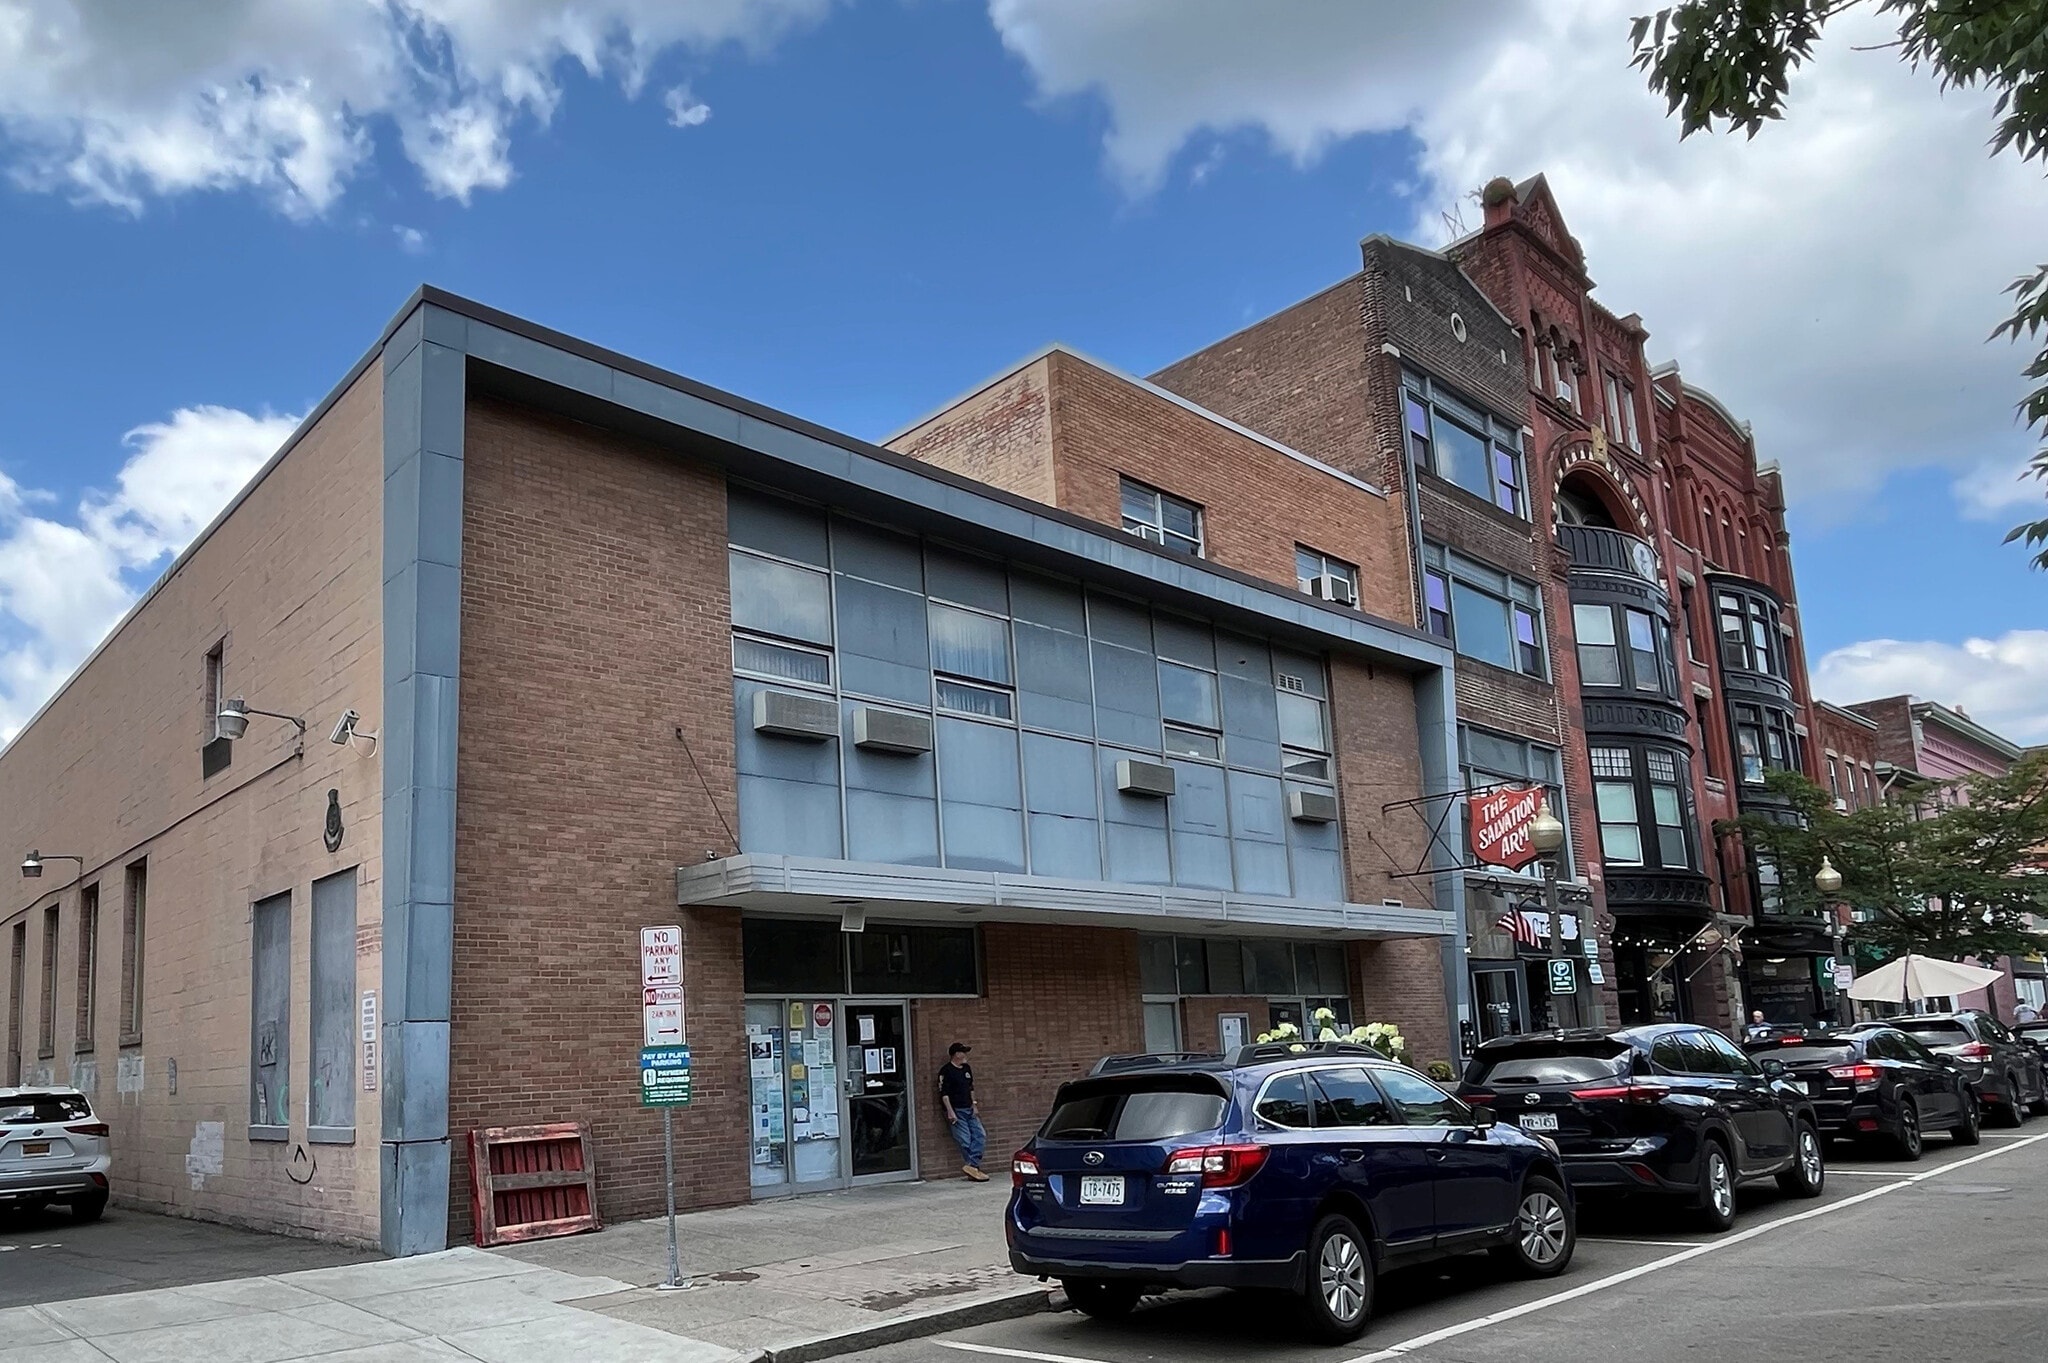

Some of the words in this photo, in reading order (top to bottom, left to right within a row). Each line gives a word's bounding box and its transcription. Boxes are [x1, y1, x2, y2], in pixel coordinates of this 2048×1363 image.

[1482, 795, 1508, 823] THE
[1479, 792, 1535, 850] SALVATION
[654, 931, 669, 944] NO
[645, 944, 679, 957] PARKING
[654, 957, 670, 965] ANY
[653, 965, 672, 974] TIME
[645, 991, 656, 1004] NO
[656, 992, 681, 1001] PARKING
[651, 1059, 682, 1067] PARKING
[657, 1069, 689, 1077] PAYMENT
